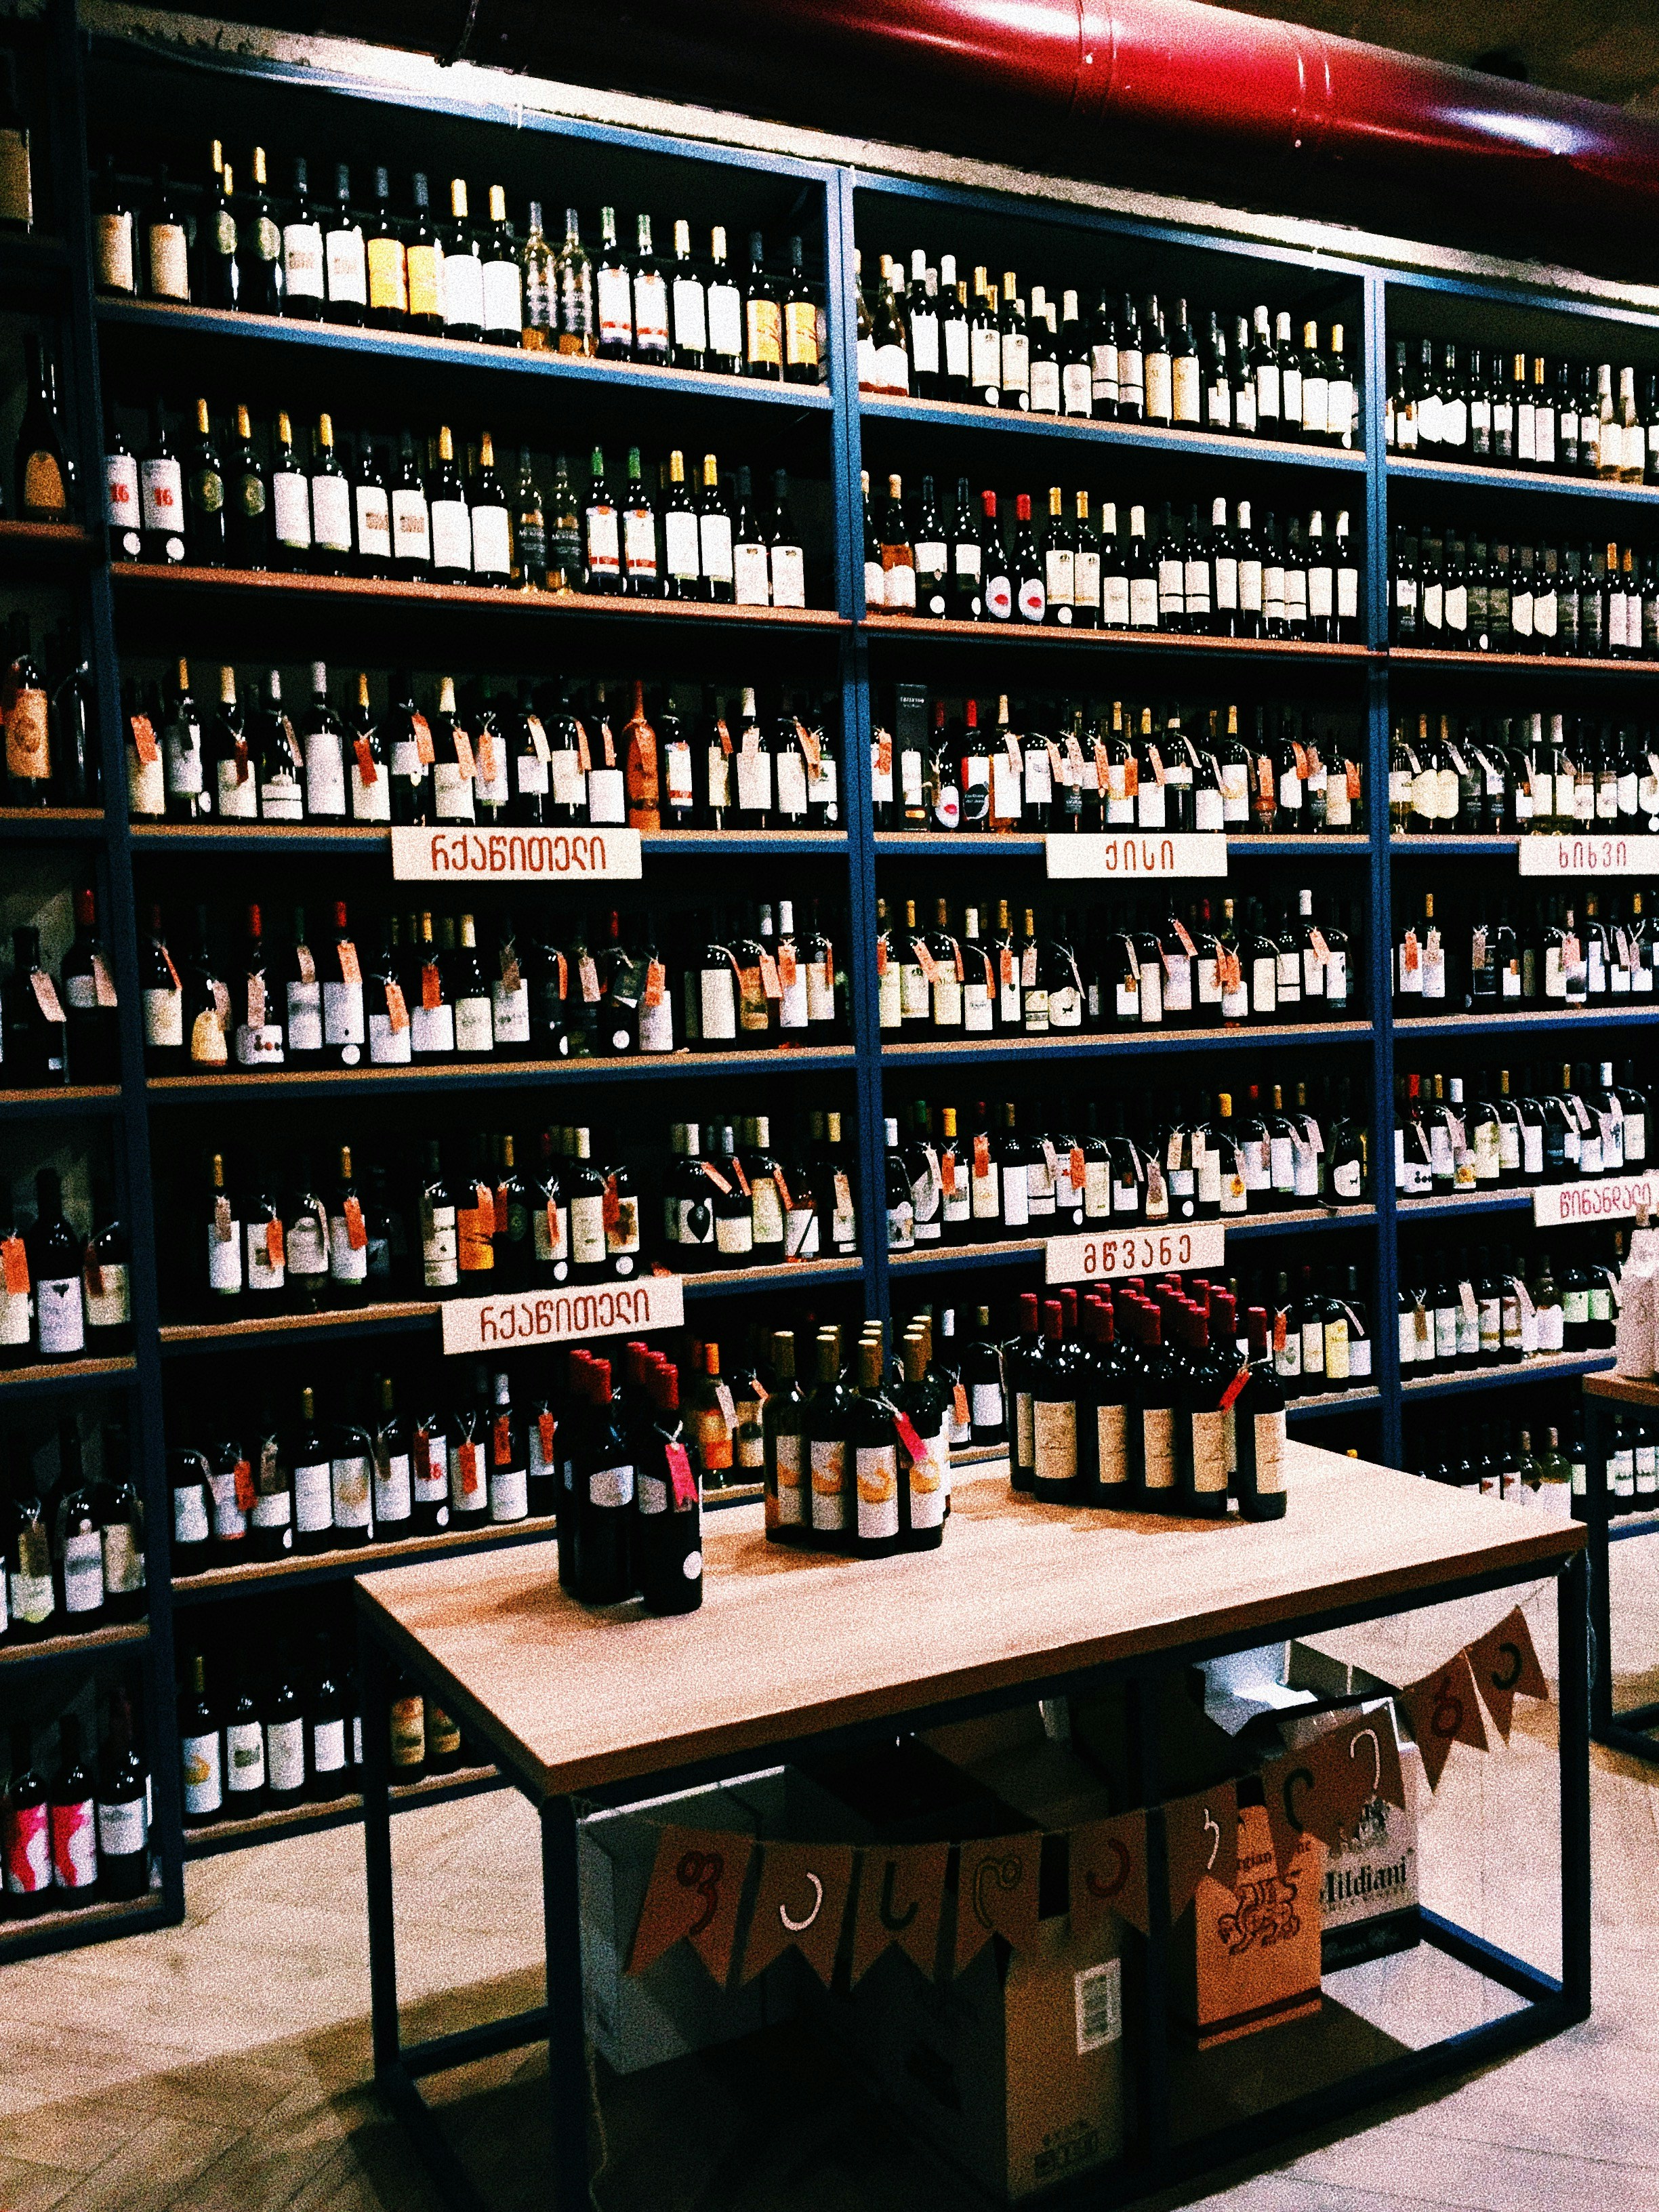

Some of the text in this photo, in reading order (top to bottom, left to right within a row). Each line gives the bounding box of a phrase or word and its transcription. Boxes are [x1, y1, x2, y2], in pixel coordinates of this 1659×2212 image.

[431, 834, 607, 872] რქაწითელი
[1105, 840, 1174, 871] ქისი
[1559, 841, 1626, 868] ხიხვი
[1560, 1183, 1652, 1218] წინანდალი
[1084, 1234, 1191, 1273] მწვანე
[480, 1288, 651, 1343] რქაწითელი
